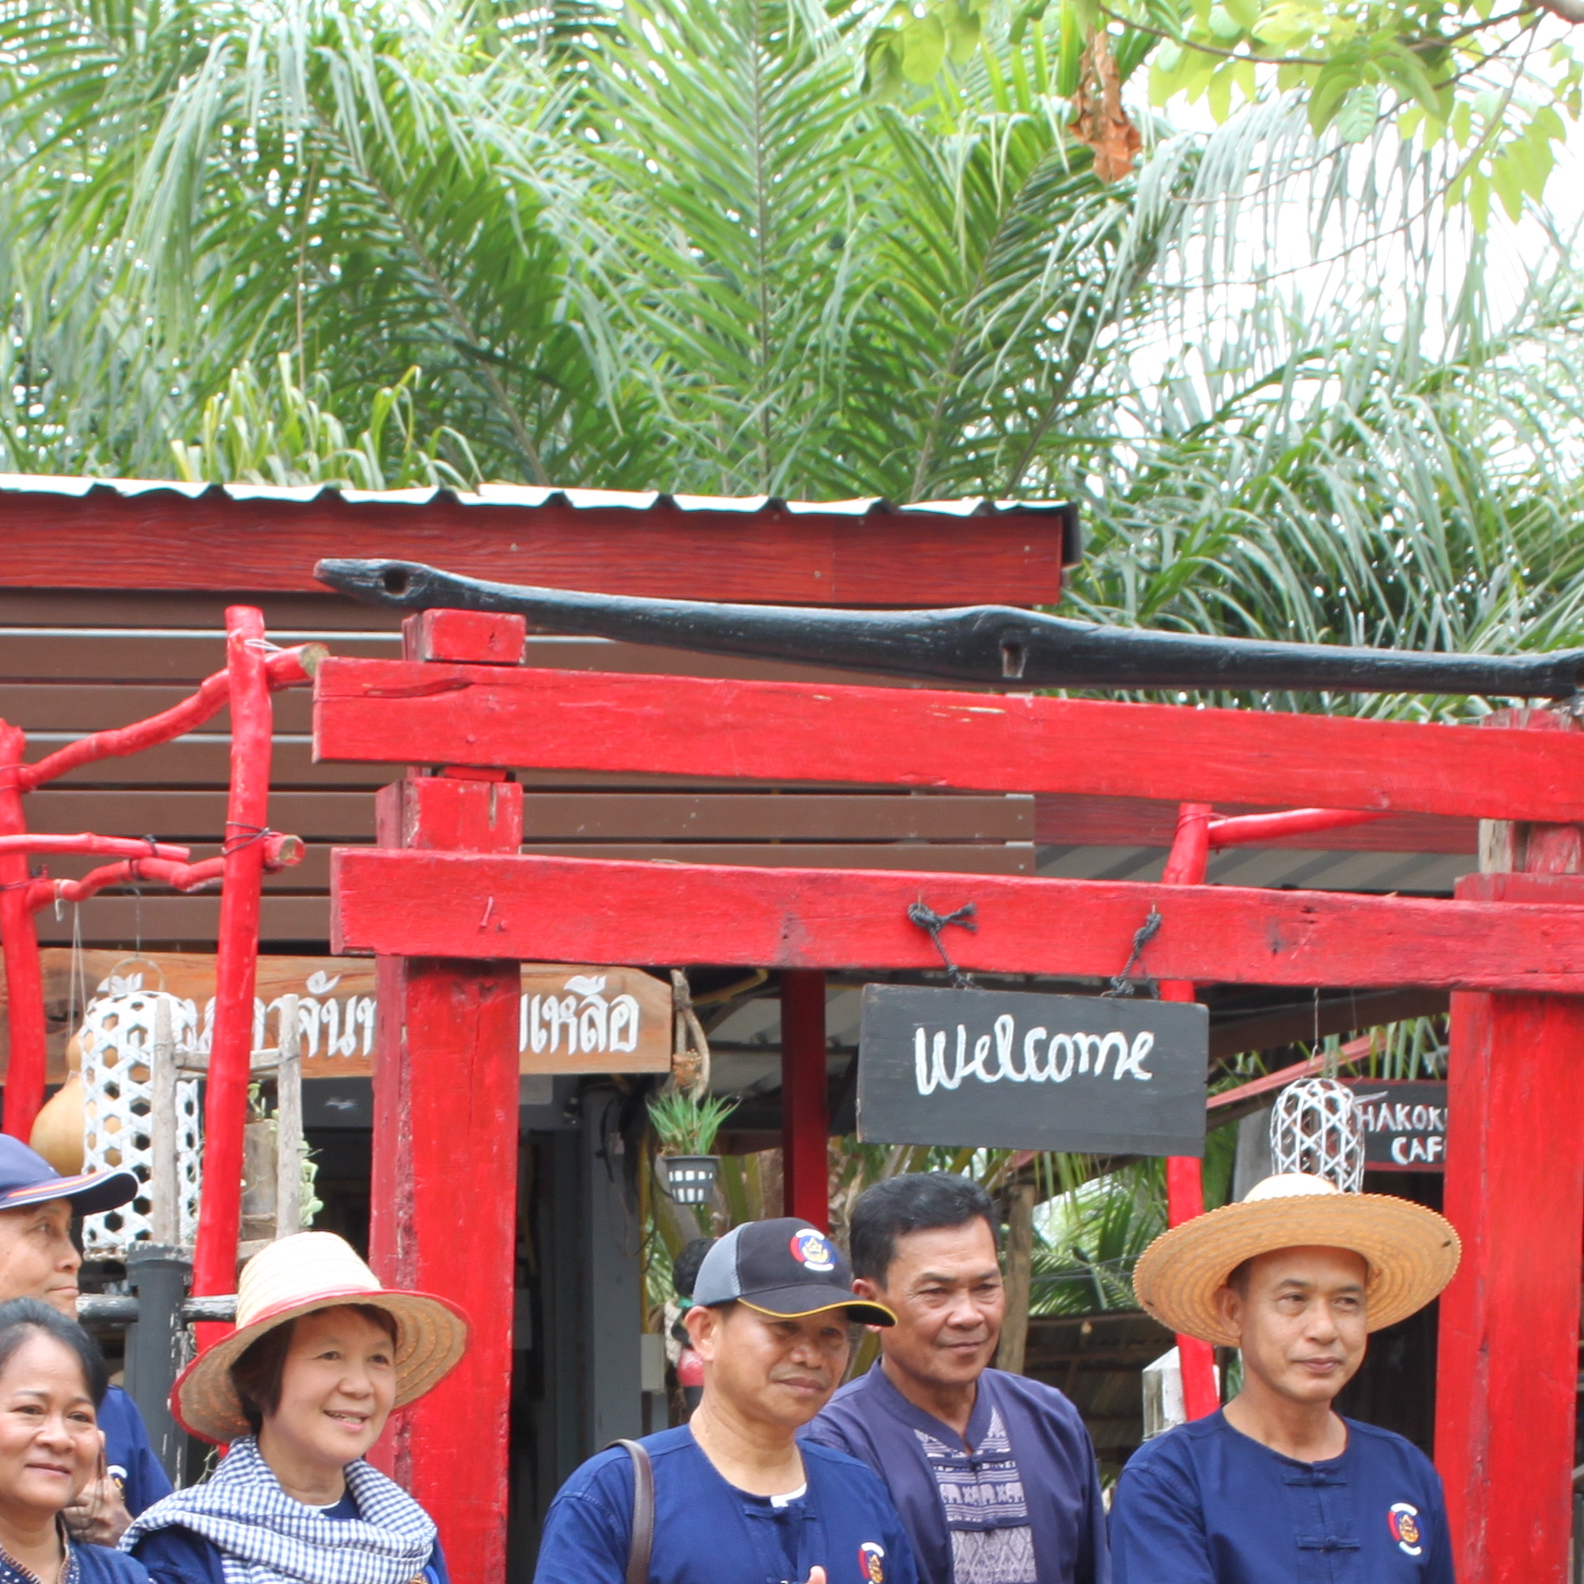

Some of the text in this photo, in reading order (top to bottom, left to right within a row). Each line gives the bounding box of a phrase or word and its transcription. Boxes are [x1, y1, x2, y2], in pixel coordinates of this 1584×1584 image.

[518, 975, 640, 1055] เหลือ
[915, 1013, 1154, 1096] Welcome
[1390, 1135, 1444, 1165] CAF
